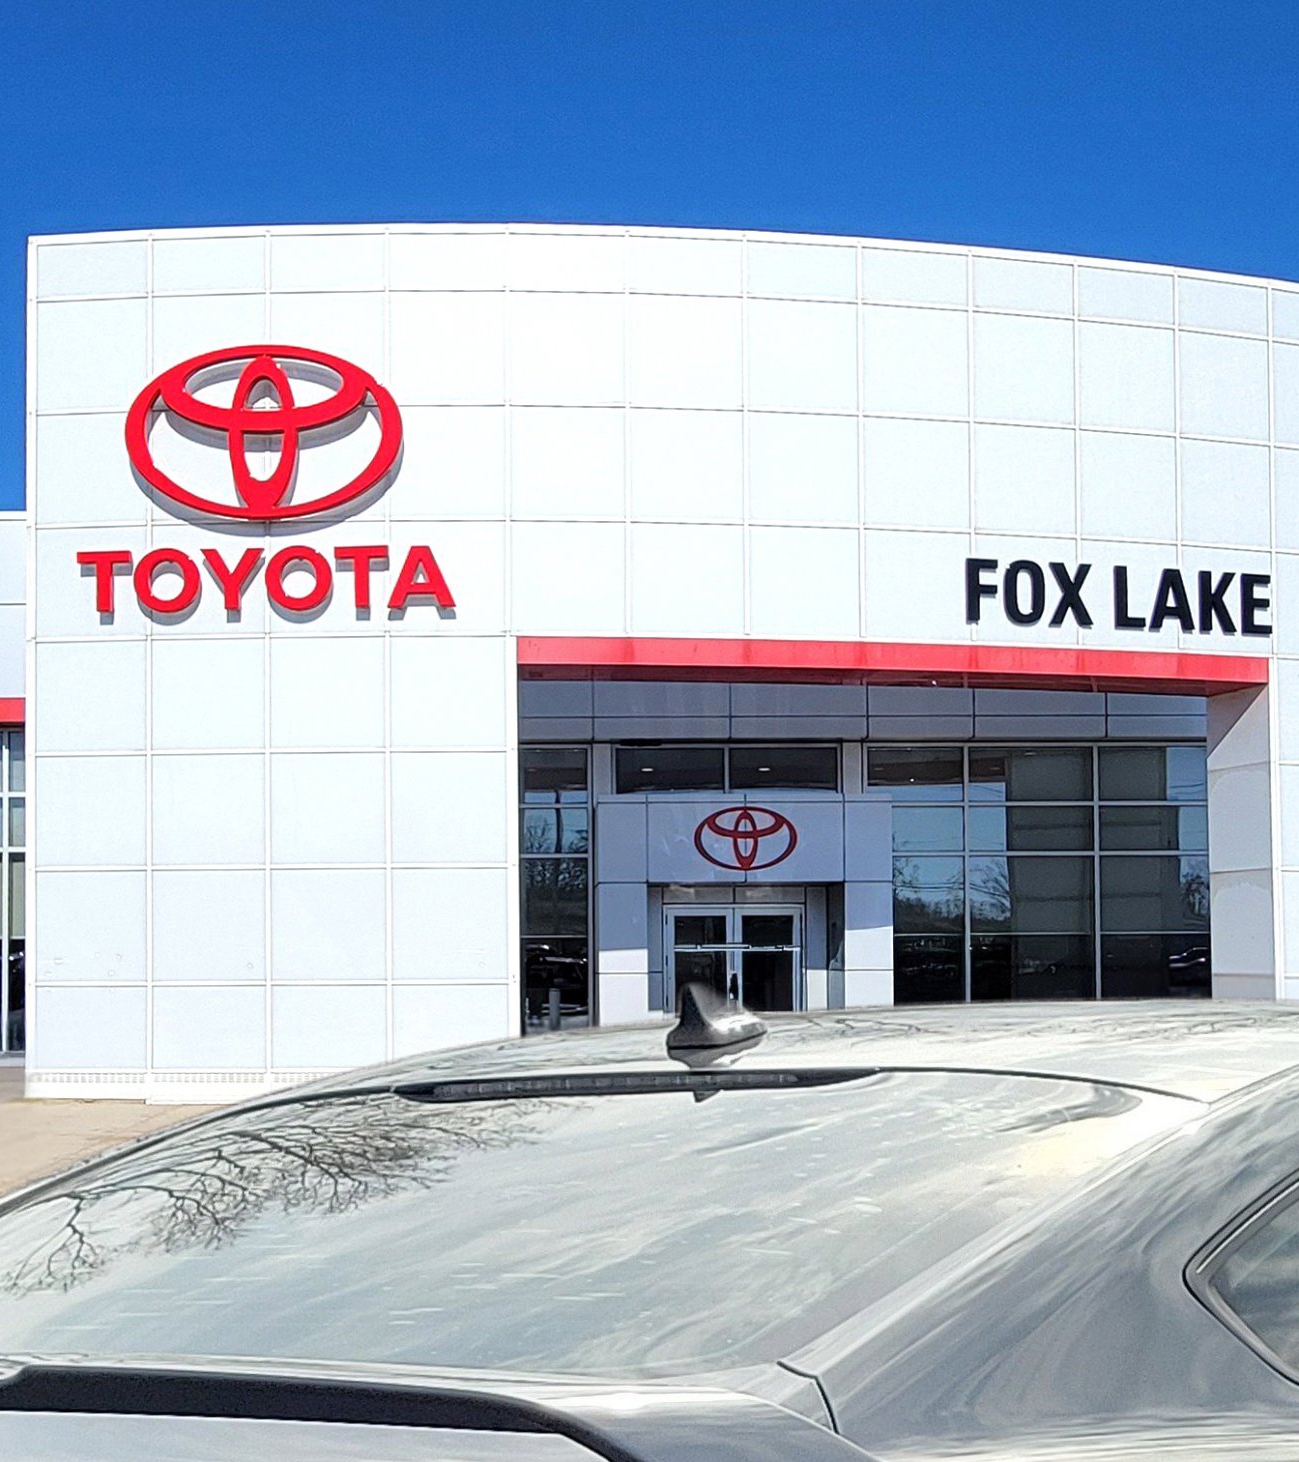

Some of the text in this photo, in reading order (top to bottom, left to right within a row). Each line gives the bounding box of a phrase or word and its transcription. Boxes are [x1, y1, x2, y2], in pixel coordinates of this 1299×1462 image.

[77, 546, 455, 613] TOYOTA
[966, 558, 1273, 635] FOX LAKE
